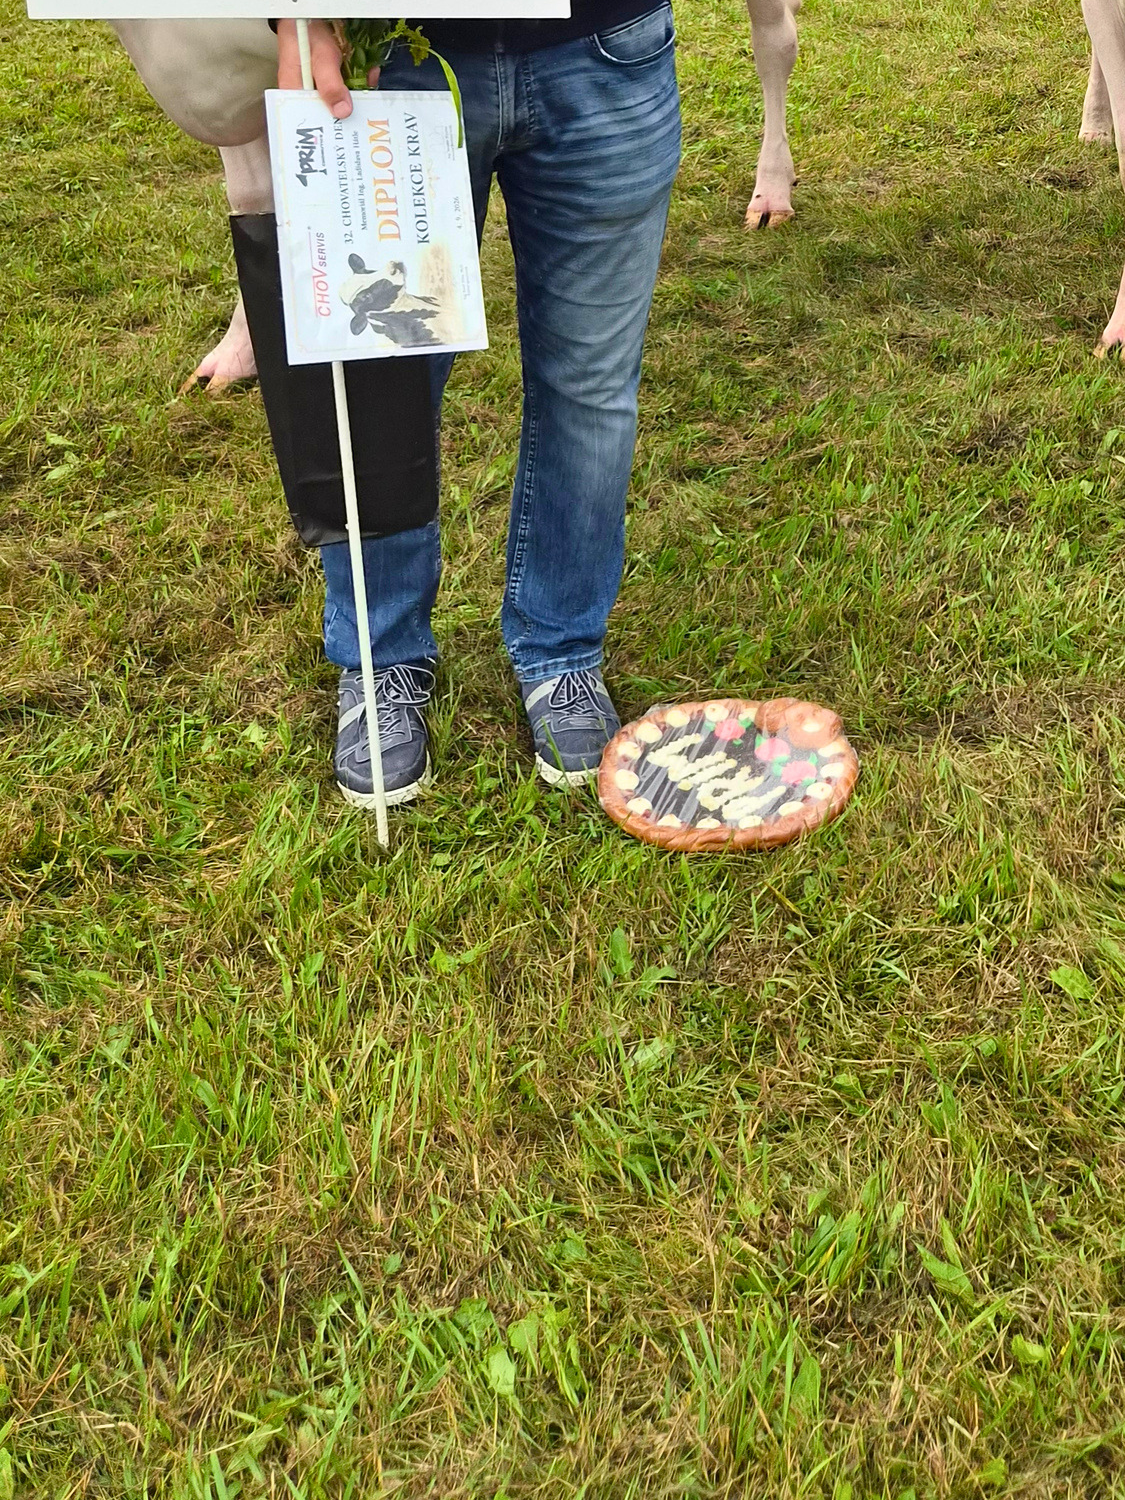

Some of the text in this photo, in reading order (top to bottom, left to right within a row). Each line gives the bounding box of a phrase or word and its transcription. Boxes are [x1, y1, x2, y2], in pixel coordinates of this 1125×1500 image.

[335, 145, 352, 227] CHOVATELSKÝ
[367, 118, 401, 242] DIPLOM
[404, 112, 430, 244] KOLEKCE KRAV
[344, 230, 354, 245] 32.
